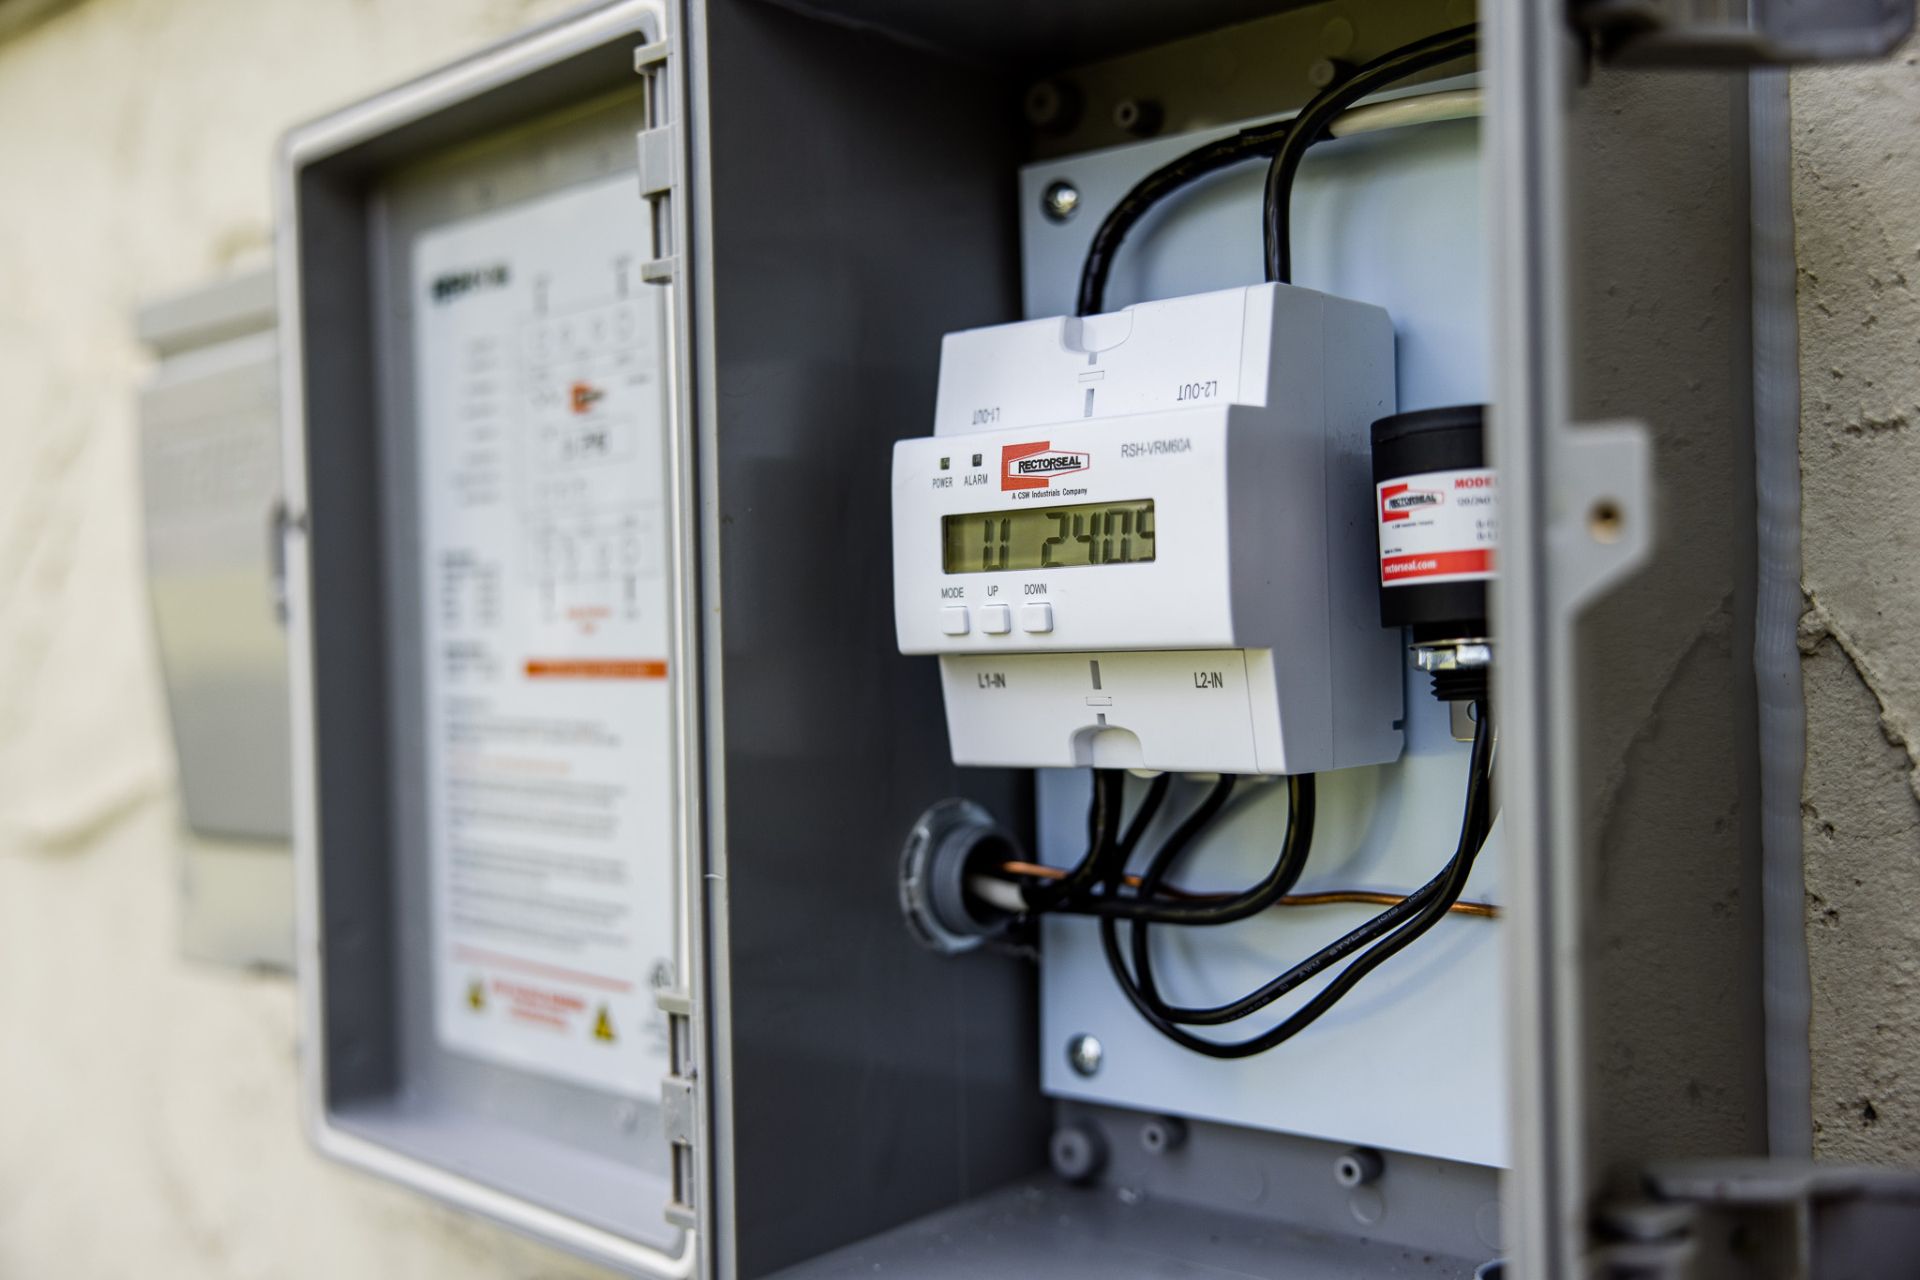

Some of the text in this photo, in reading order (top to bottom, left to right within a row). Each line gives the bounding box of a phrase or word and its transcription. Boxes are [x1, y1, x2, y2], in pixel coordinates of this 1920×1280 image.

[1177, 380, 1218, 401] L2-OUT
[972, 407, 1000, 425] L1-OUT
[1121, 438, 1191, 458] RSH-VRM60A
[1018, 455, 1081, 474] RECTORSEAL
[932, 474, 988, 488] POWER ALARM
[1031, 489, 1060, 498] Industrials
[1062, 488, 1088, 497] Company
[941, 584, 1047, 598] MODE UP DOWN
[978, 671, 1223, 689] L1-IN L2-IN
[1329, 928, 1368, 956] STYLE
